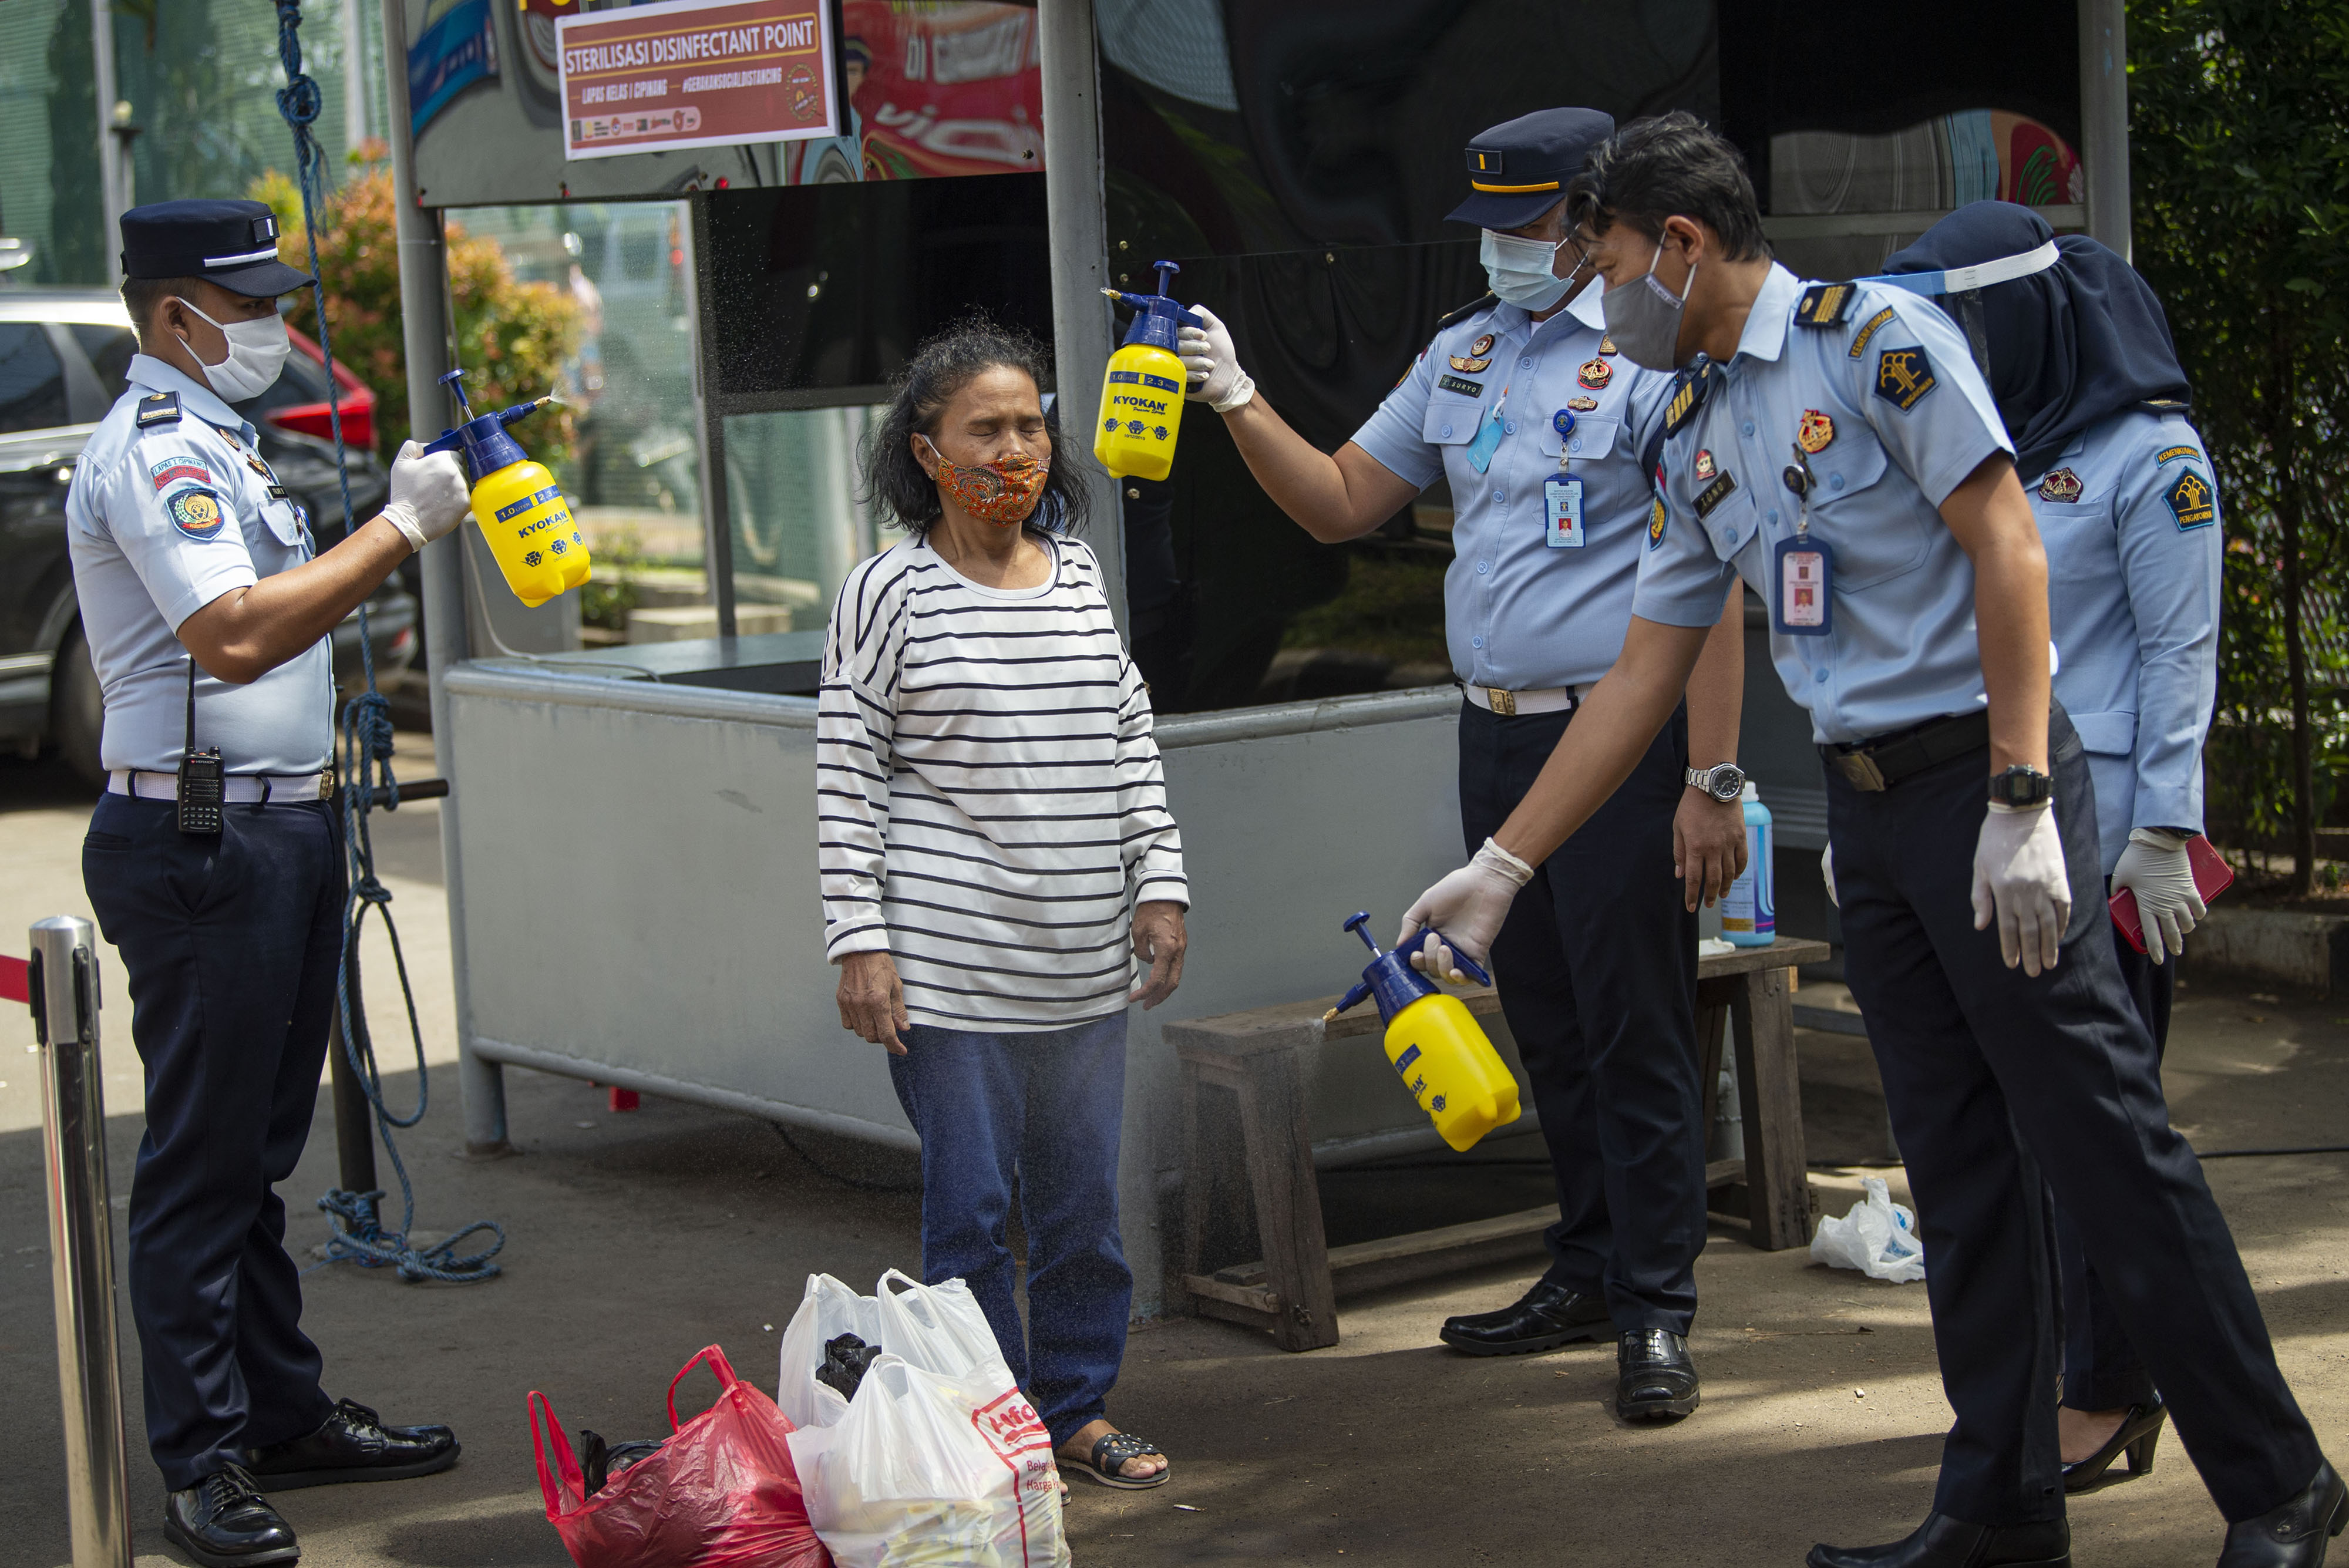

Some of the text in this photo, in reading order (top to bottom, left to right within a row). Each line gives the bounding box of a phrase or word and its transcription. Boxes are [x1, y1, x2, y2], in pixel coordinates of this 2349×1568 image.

[566, 20, 813, 74] STERILISASI DISINFECTANT POINT
[581, 86, 605, 105] LAPAS
[1146, 377, 1163, 387] 2.3
[1452, 382, 1476, 392] SURYO
[1113, 395, 1166, 412] KYOKAN
[154, 462, 172, 474] LAPAS
[178, 459, 205, 469] CIPINANG
[538, 490, 553, 501] 2.3
[500, 502, 531, 519] 1.0 LITER
[2179, 510, 2212, 524] PENGAYOMAN
[518, 510, 568, 539] KYOKAN
[1027, 1479, 1052, 1492] Harga
